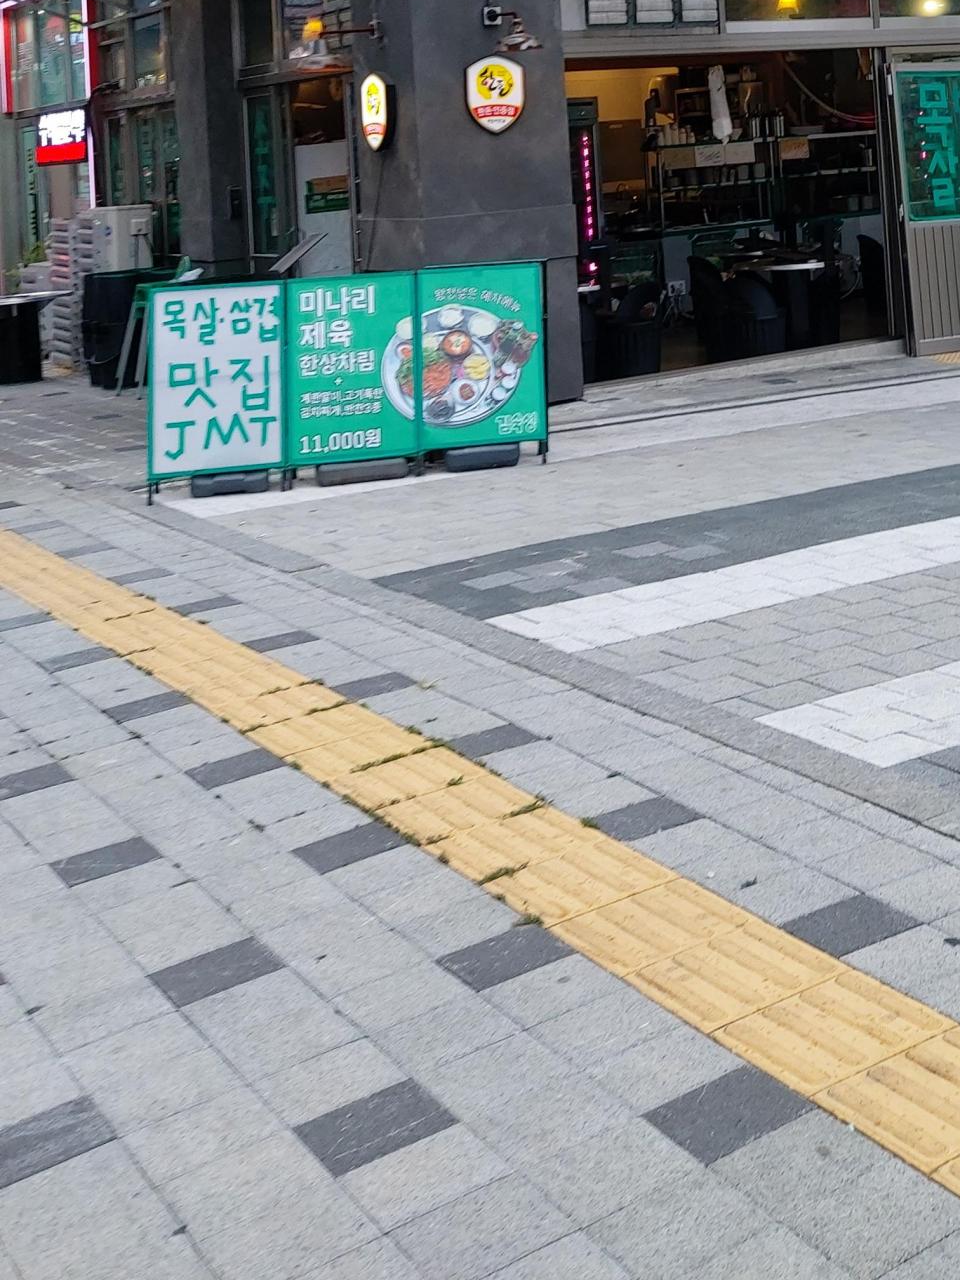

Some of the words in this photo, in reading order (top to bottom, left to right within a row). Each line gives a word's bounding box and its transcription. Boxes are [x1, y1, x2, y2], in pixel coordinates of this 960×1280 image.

[298, 284, 376, 317] 미나리
[298, 318, 353, 349] 제육
[299, 349, 375, 377] 한상차림
[168, 354, 270, 411] 맛집
[164, 413, 277, 460] JMT
[299, 427, 382, 454] 11,000원
